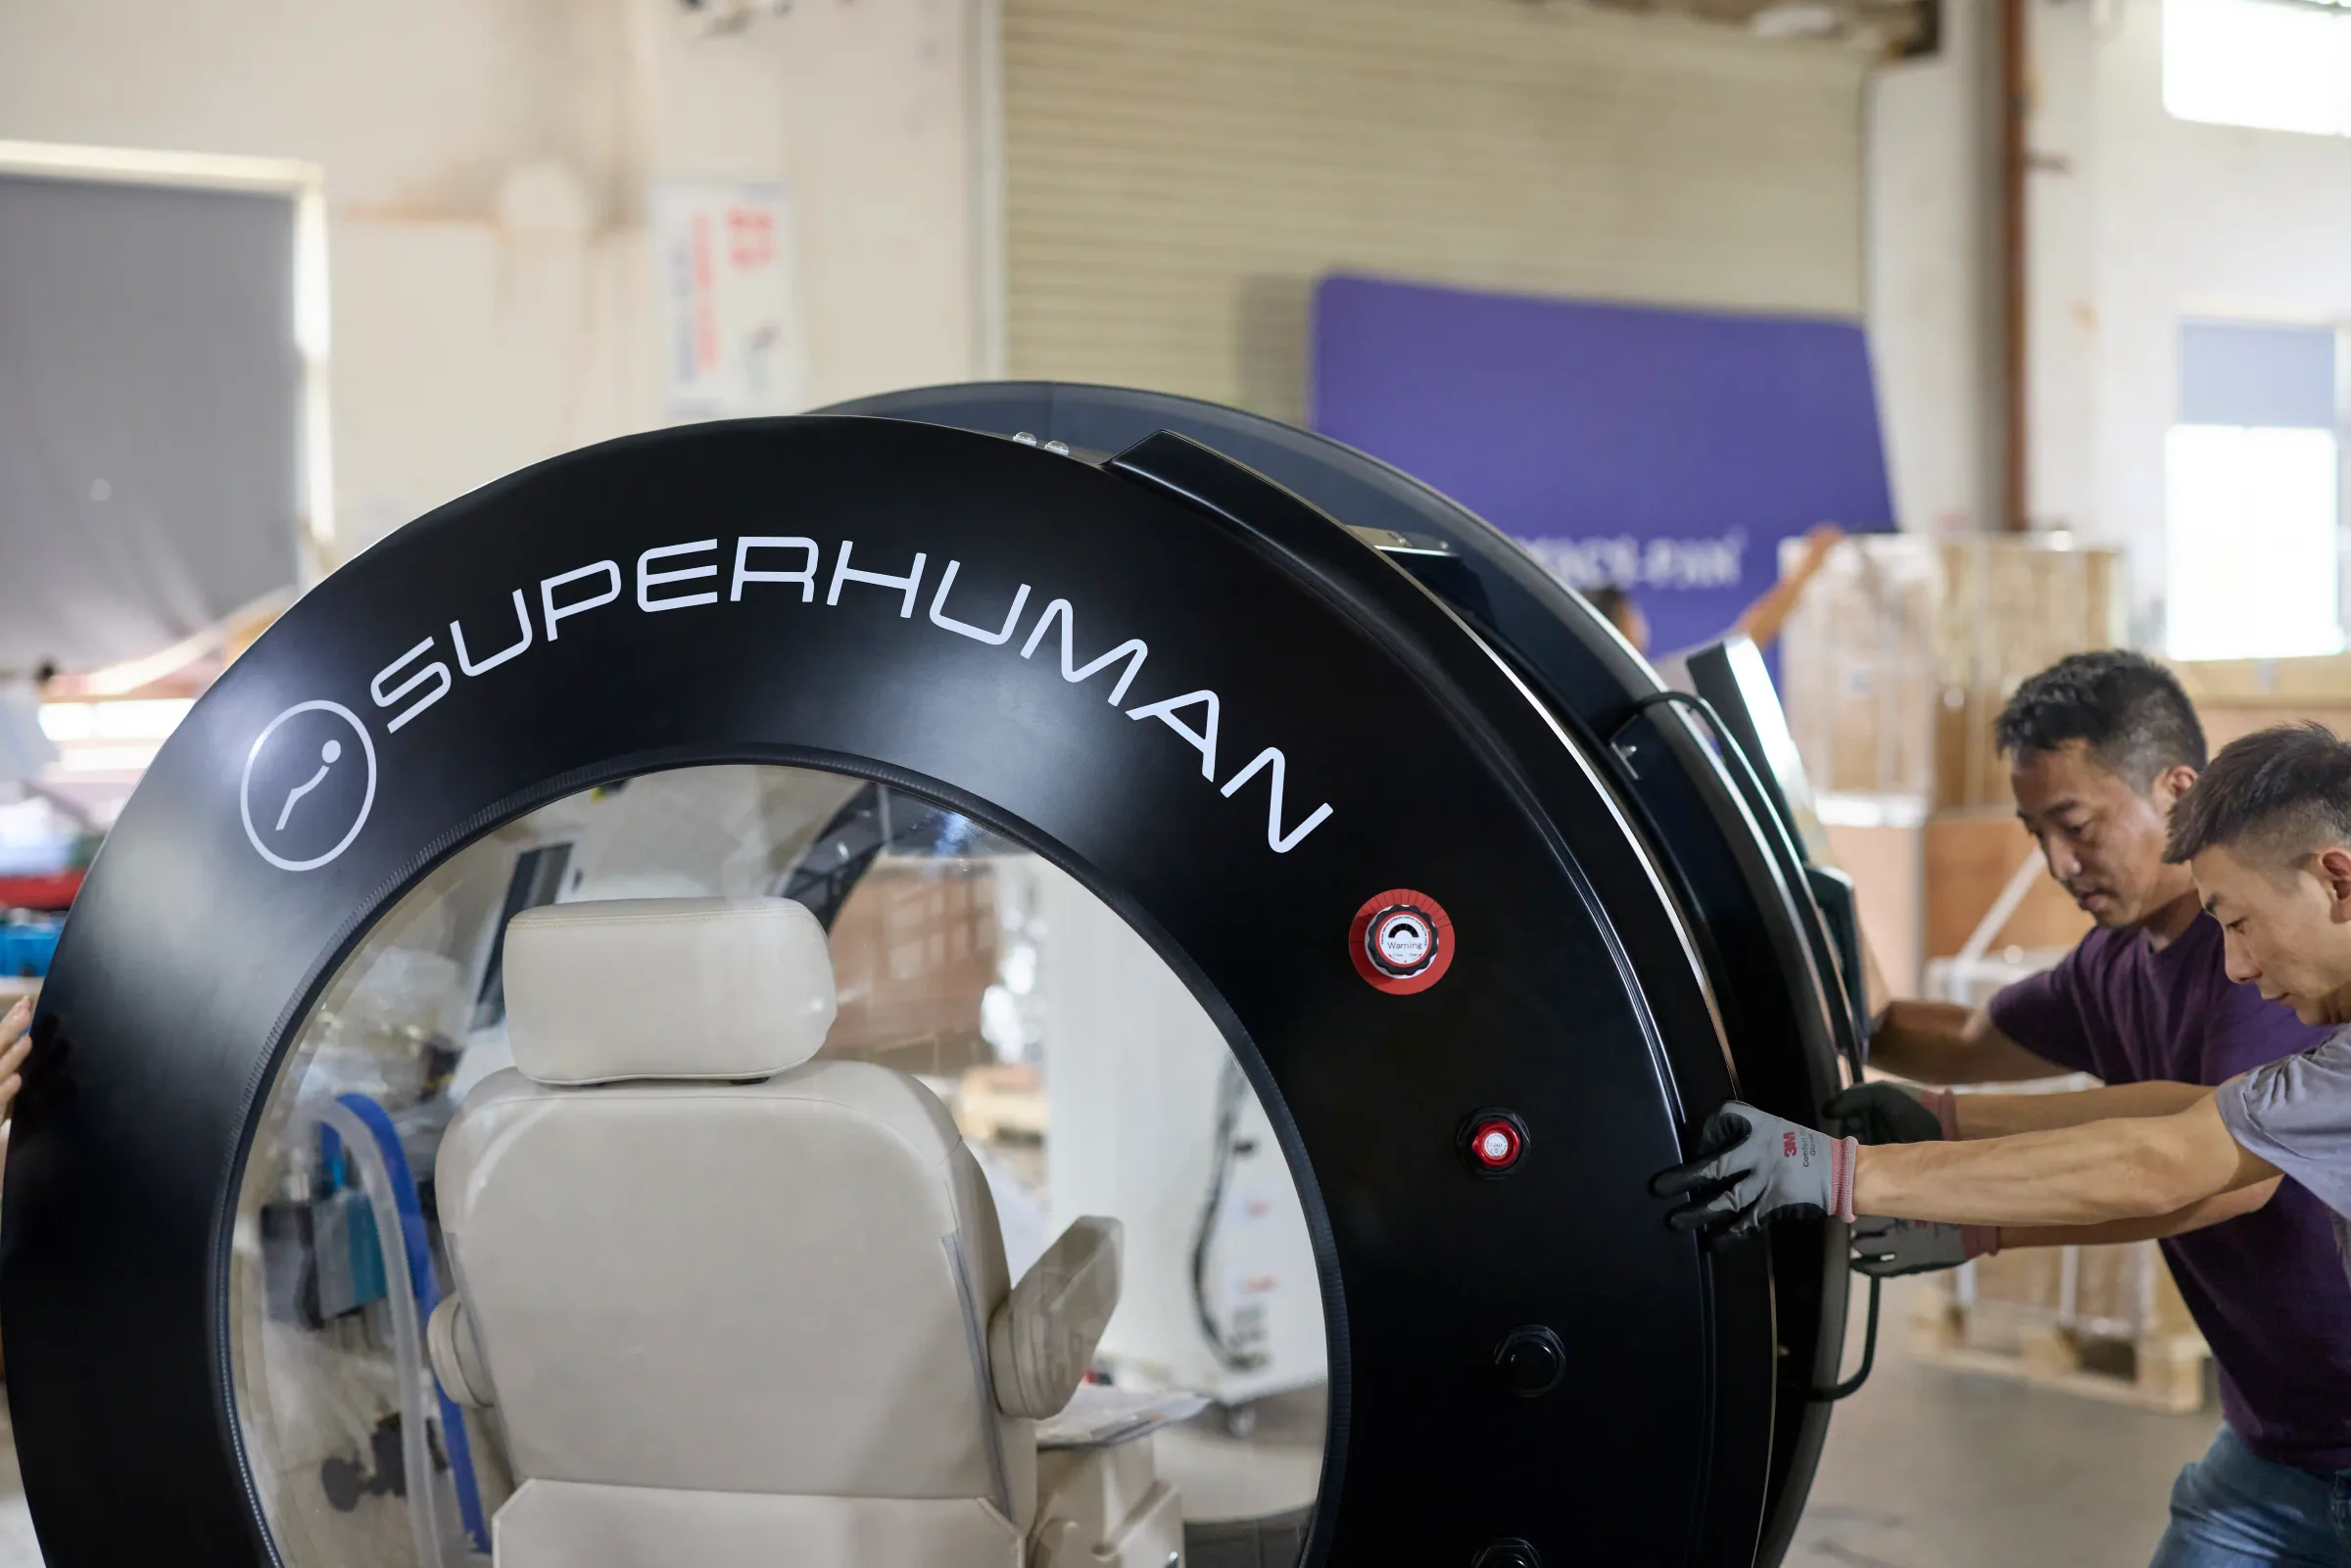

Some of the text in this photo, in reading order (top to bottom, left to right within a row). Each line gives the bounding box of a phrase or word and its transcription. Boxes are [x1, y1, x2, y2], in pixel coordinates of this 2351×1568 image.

[371, 536, 1334, 854] SUPERHUMAN
[1387, 941, 1422, 950] Warning
[1783, 1131, 1798, 1158] 3M
[1800, 1137, 1809, 1167] Comfort
